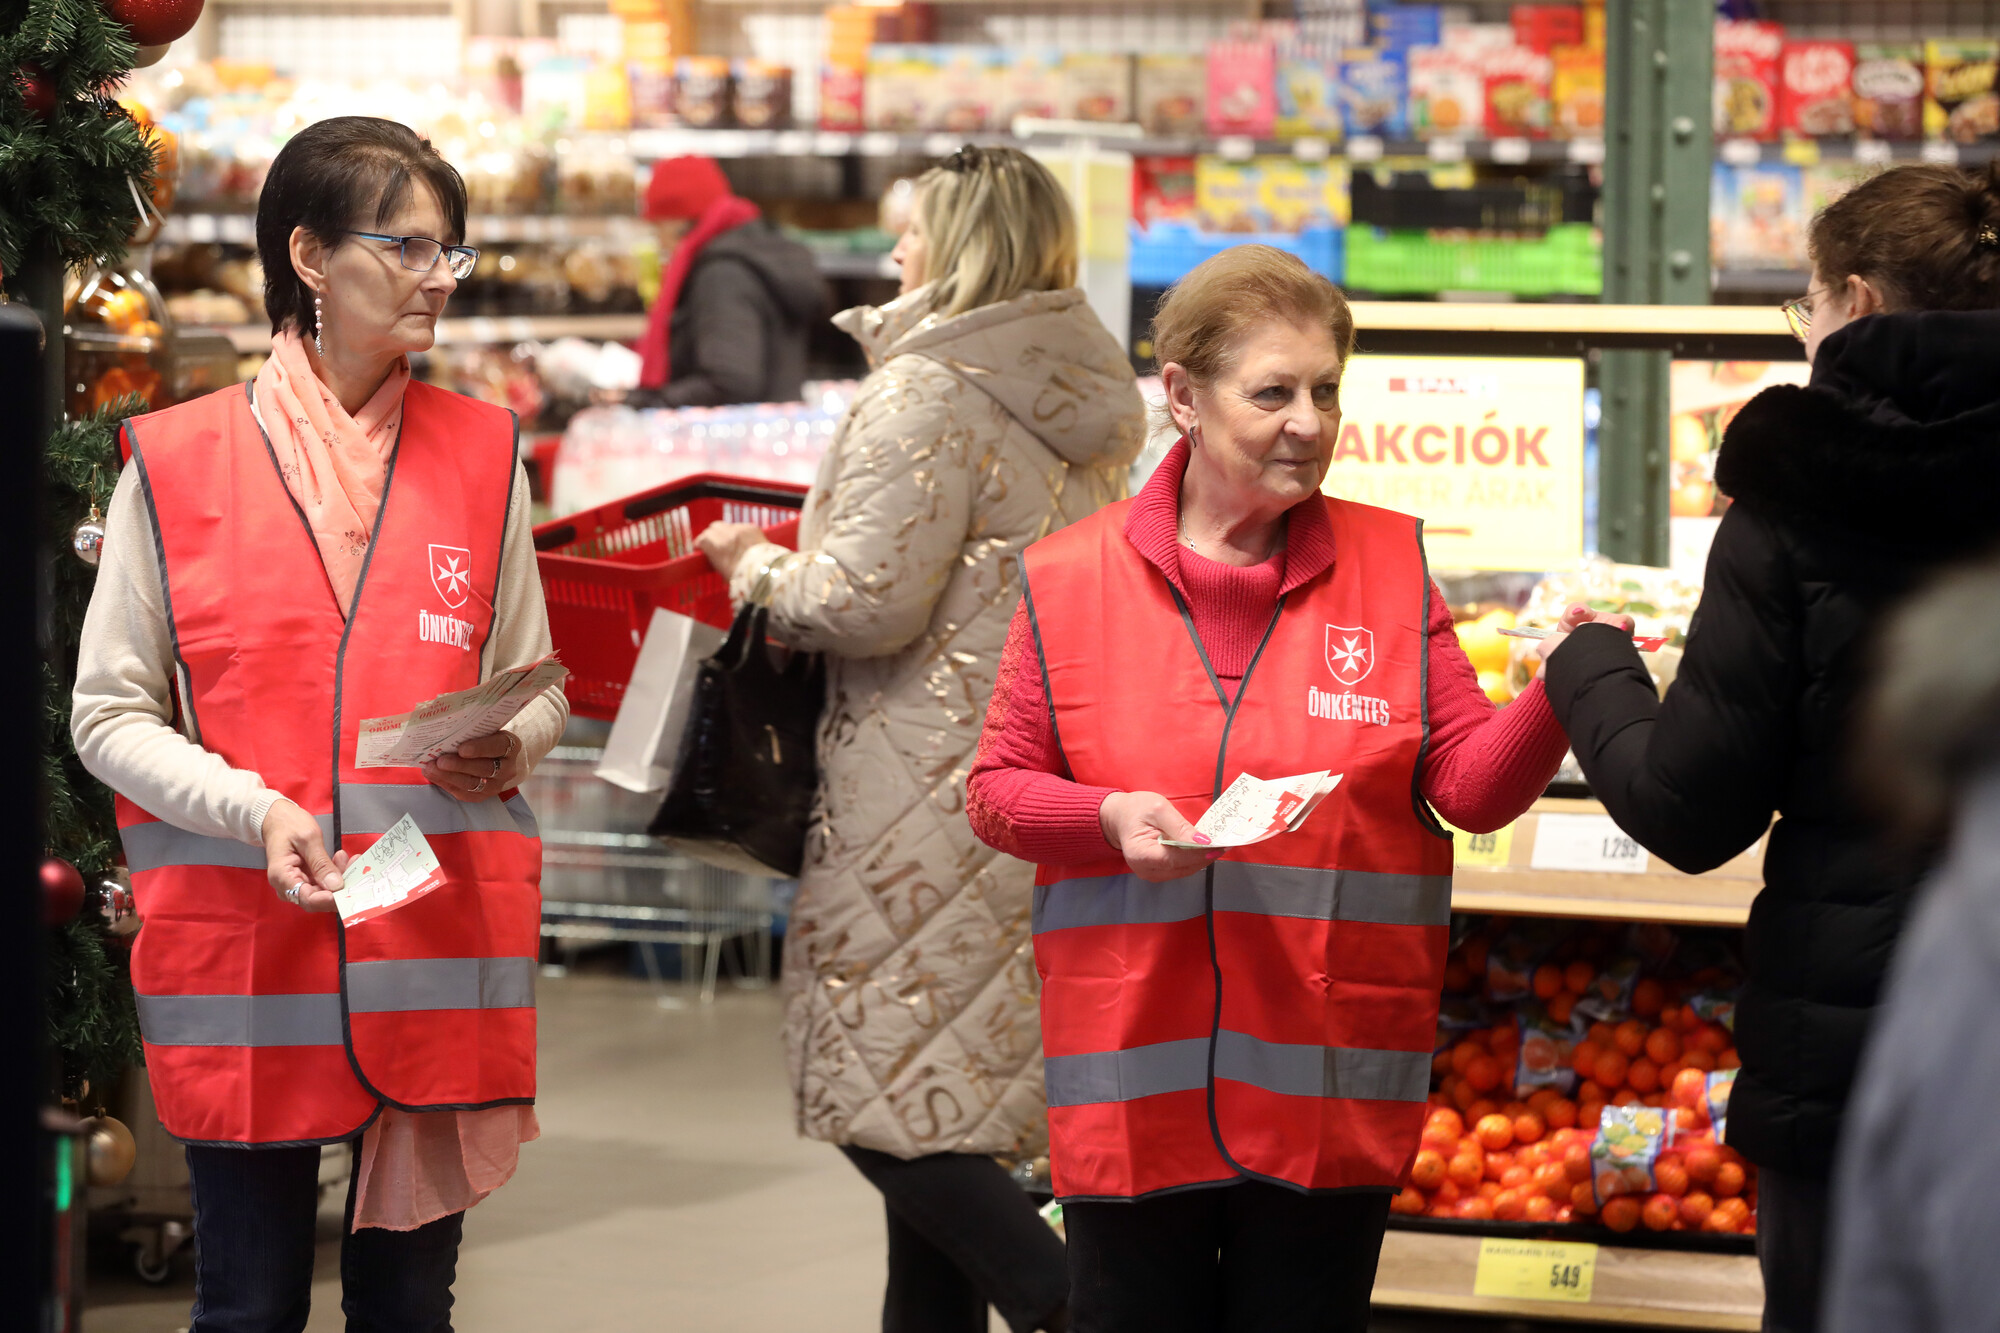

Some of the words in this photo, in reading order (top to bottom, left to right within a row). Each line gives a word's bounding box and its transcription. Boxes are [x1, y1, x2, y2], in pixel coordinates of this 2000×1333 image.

[1333, 411, 1550, 467] AKCIÓK
[1308, 685, 1390, 727] ÖNKÉNTES
[1467, 833, 1497, 855] 499
[1549, 1264, 1581, 1289] 549
